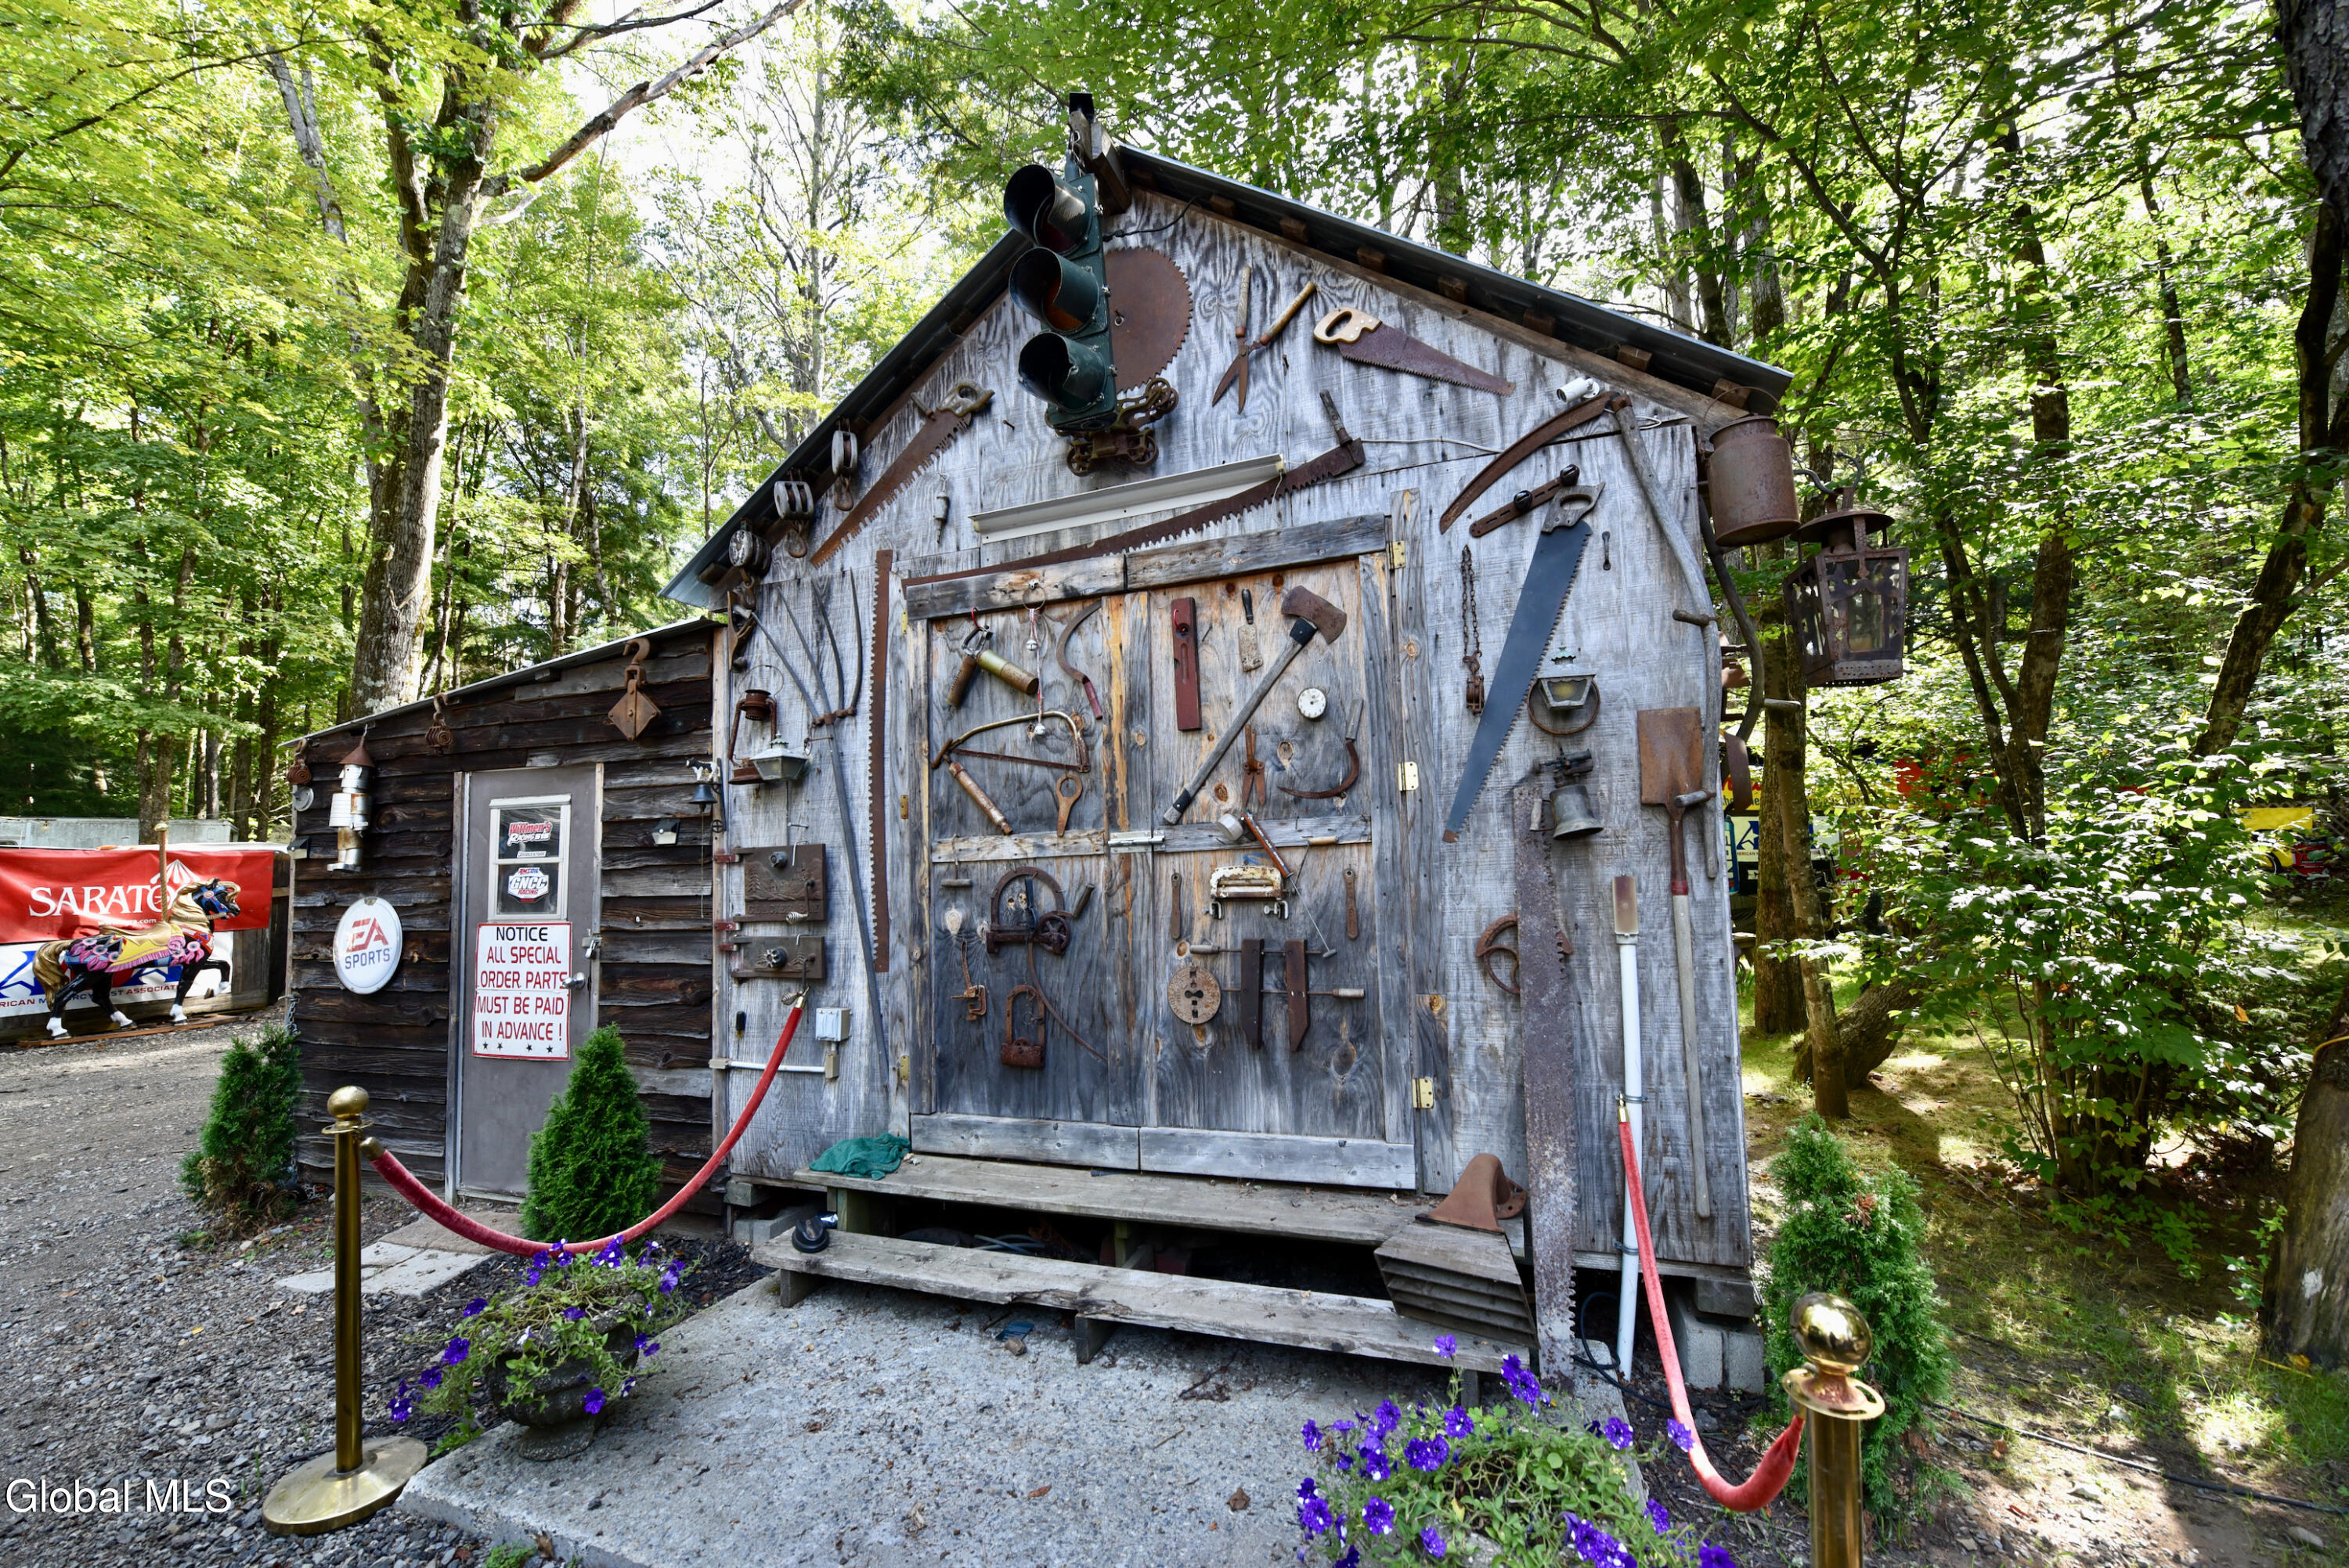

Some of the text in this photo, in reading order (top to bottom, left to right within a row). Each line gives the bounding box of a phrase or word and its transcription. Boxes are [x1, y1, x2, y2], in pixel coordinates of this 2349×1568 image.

[511, 876, 547, 889] GNCC
[346, 917, 390, 953] EA
[496, 927, 548, 942] NOTICE
[345, 948, 391, 970] SPORTS
[486, 946, 561, 964] ALL SPECIAL
[480, 971, 568, 989] ORDER PARTS
[477, 996, 565, 1015] MUST BE PAID
[482, 1021, 492, 1039] IN
[496, 1022, 554, 1040] ADVANCE
